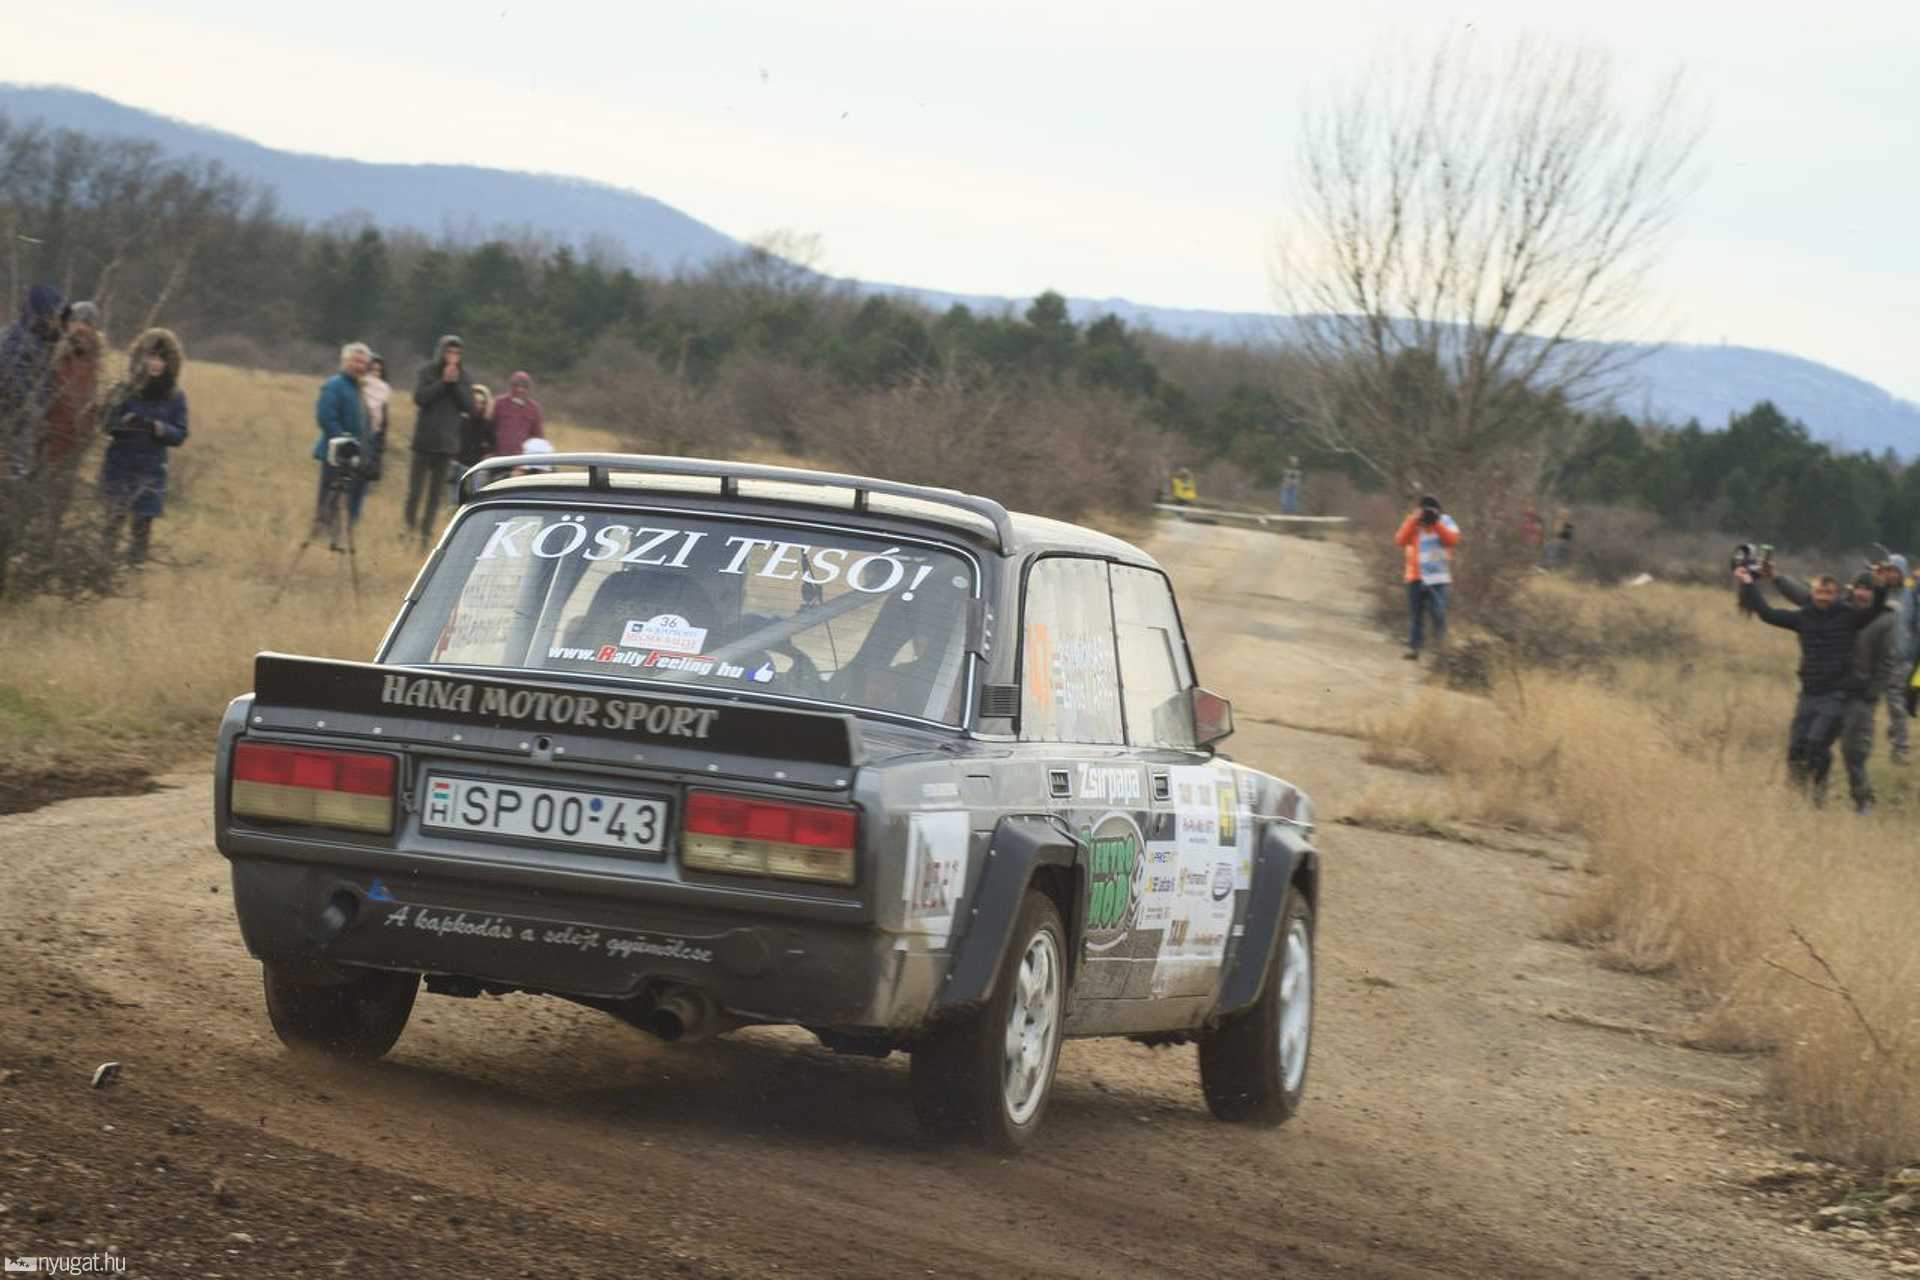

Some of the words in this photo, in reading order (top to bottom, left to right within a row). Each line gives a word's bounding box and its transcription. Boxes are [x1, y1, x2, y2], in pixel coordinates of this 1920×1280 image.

[476, 514, 708, 568] KÖSZI
[718, 536, 933, 601] TESÓ!
[660, 616, 678, 629] 36
[381, 674, 474, 713] HANA
[479, 687, 599, 727] MOTOR
[602, 700, 720, 739] SPORT
[430, 802, 449, 823] H
[384, 906, 411, 926] A
[414, 908, 514, 938] kapkodás
[520, 929, 535, 942] a
